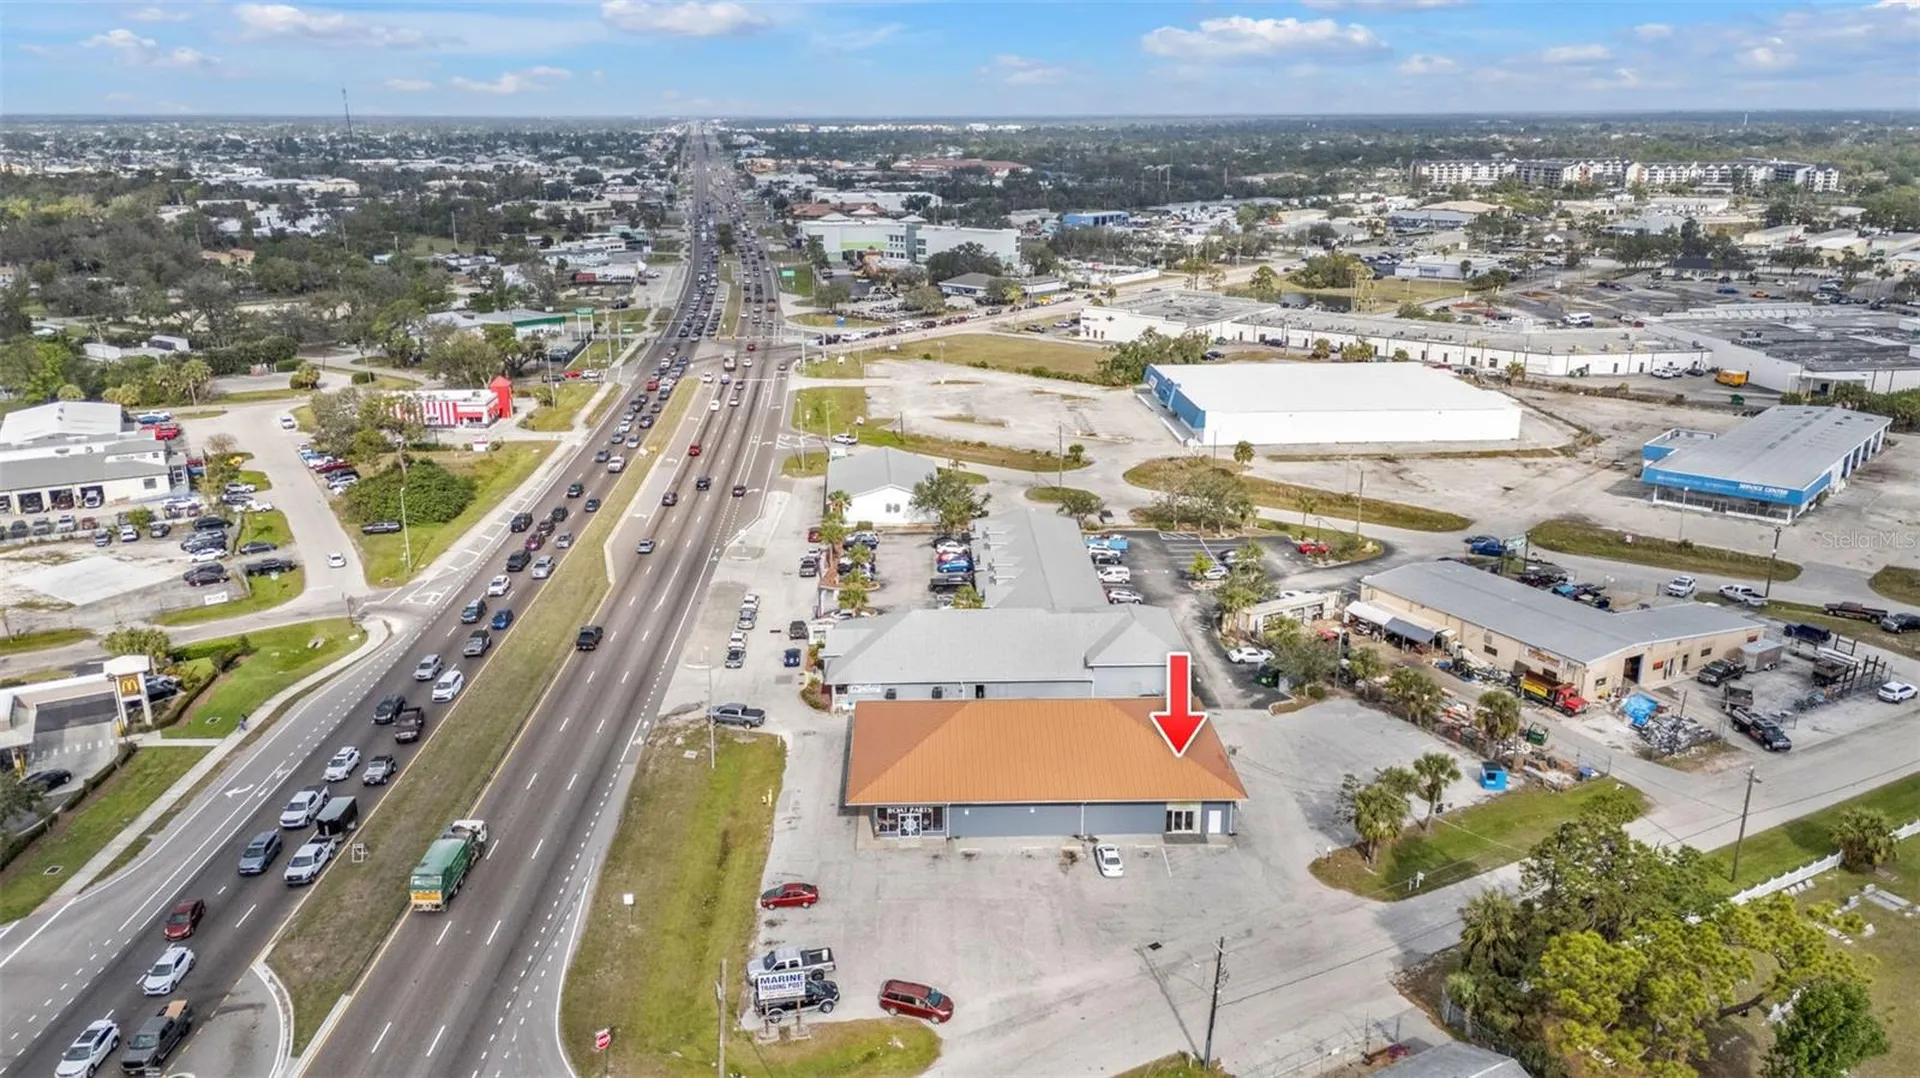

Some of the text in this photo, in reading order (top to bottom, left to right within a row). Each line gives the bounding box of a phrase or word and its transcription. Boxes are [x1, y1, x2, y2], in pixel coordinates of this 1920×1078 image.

[760, 973, 803, 985] MARINE
[761, 981, 803, 991] TRADING POST
